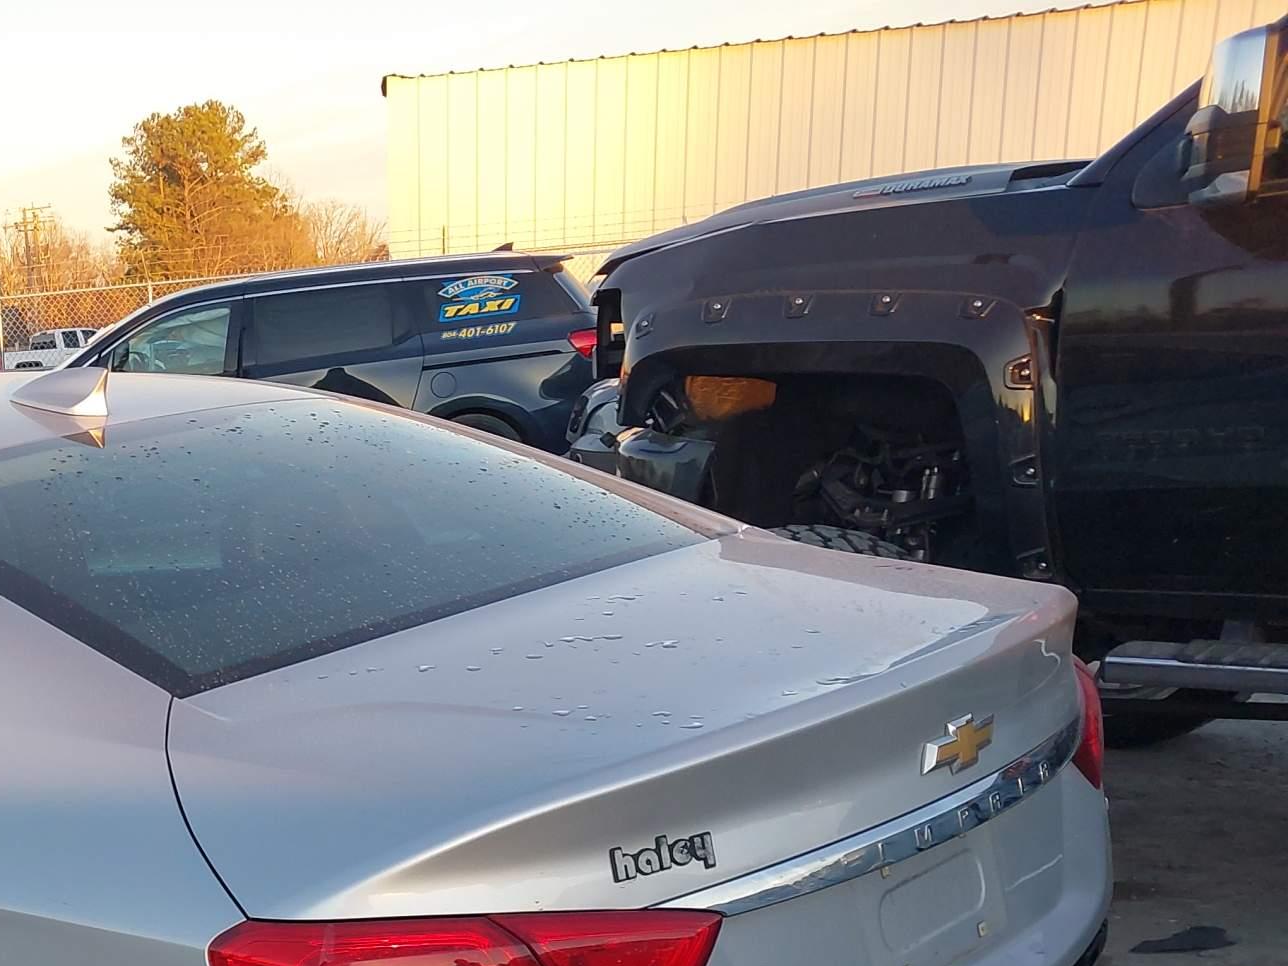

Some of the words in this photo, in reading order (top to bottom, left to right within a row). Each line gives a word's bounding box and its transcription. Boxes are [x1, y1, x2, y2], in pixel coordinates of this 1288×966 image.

[447, 283, 465, 295] ALL
[467, 278, 508, 287] AIRPORT
[444, 298, 516, 318] TAXI
[876, 760, 1050, 854] IMPALA
[609, 831, 716, 883] haley
